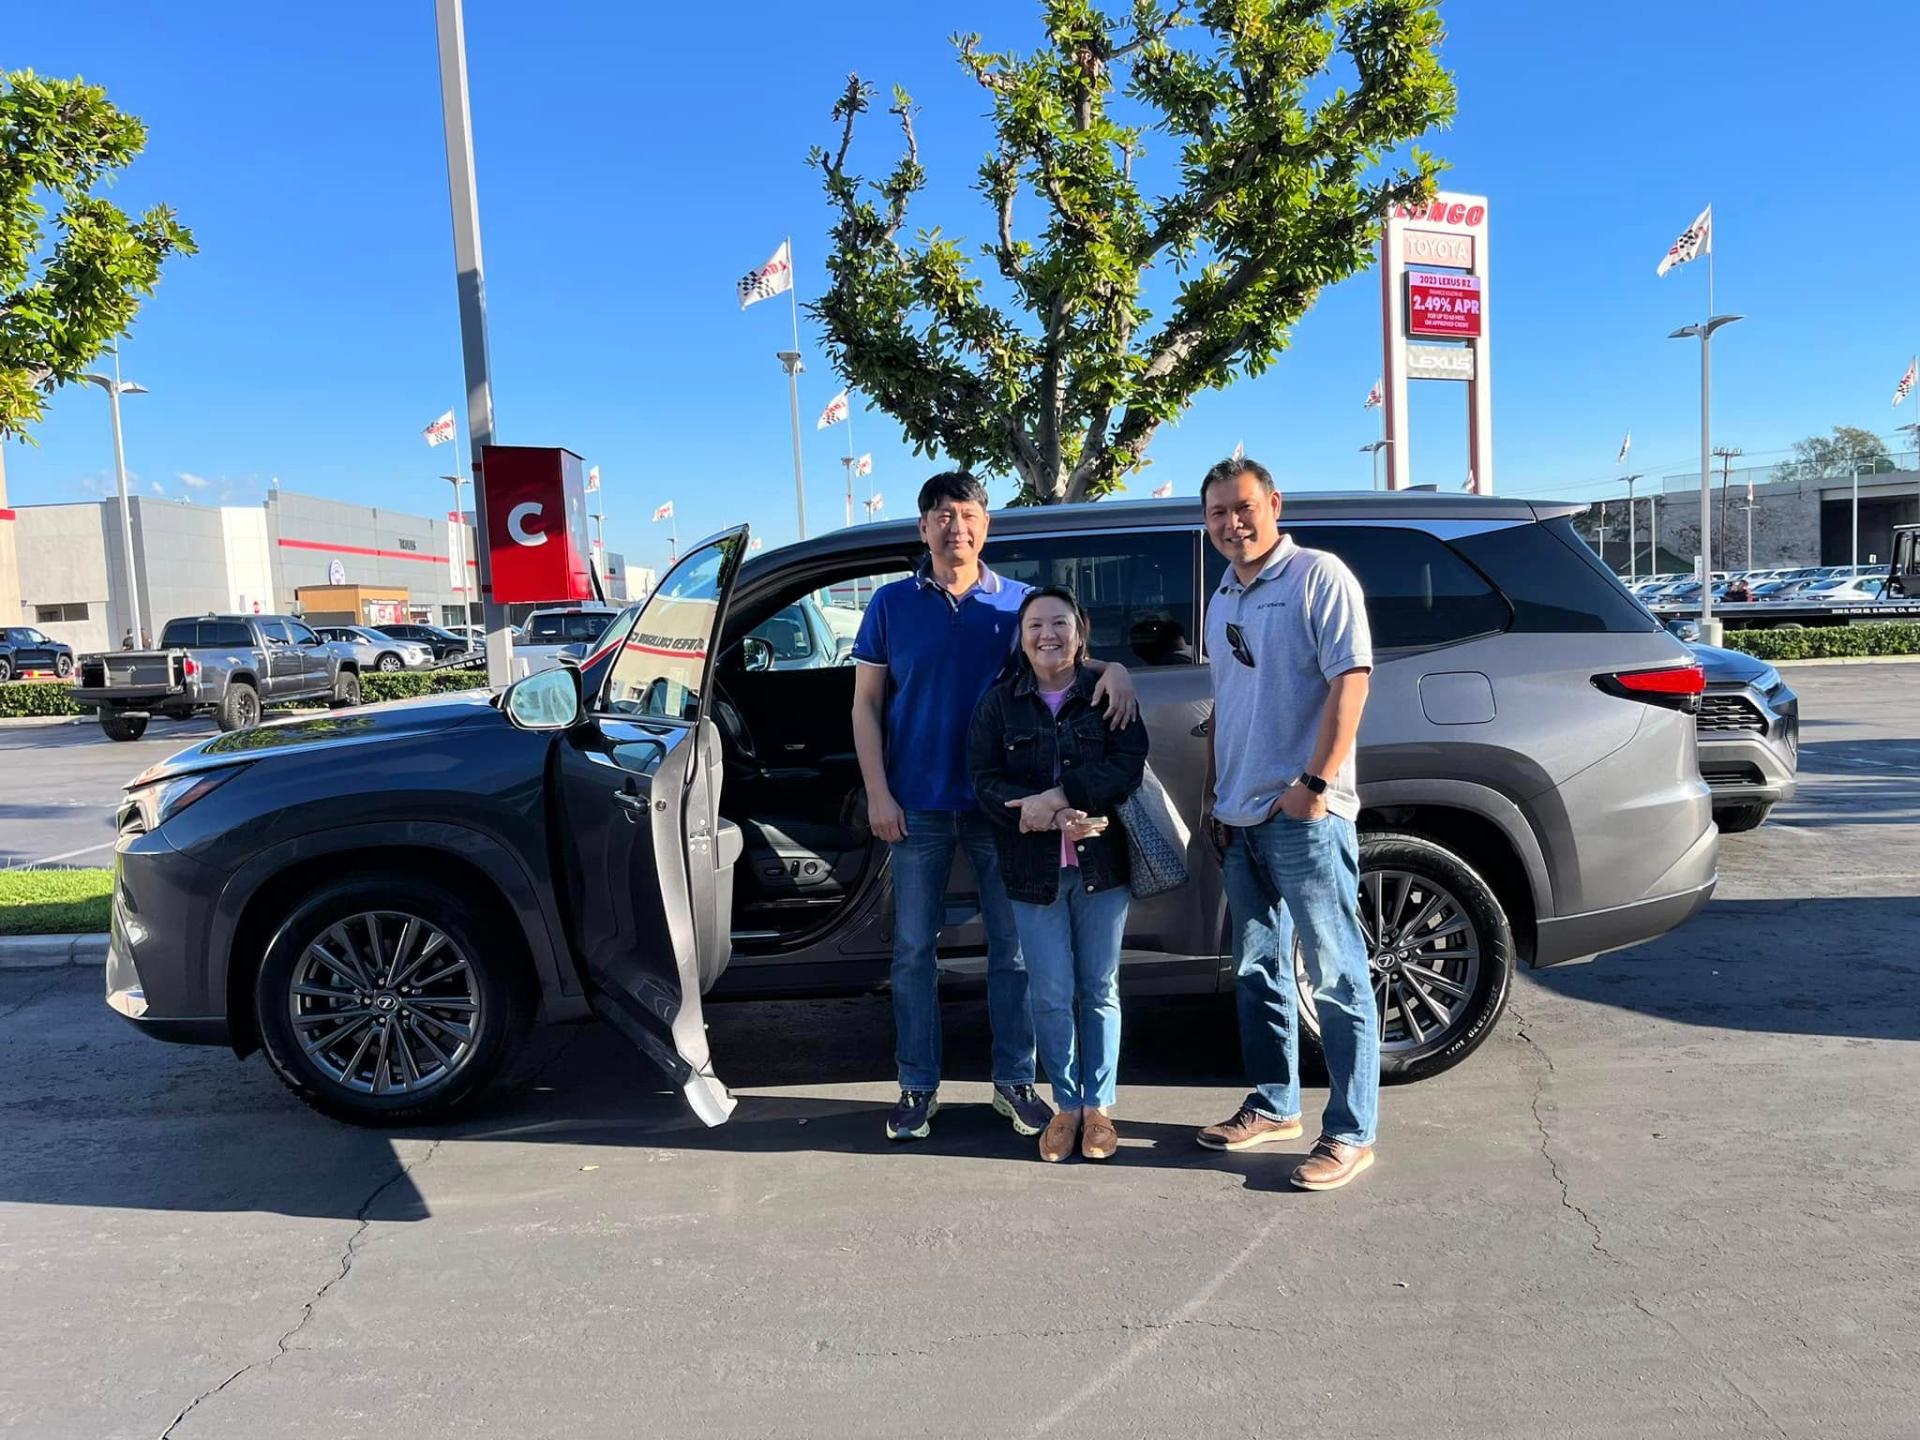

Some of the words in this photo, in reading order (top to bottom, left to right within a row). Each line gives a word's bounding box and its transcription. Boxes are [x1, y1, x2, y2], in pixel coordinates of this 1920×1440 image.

[1407, 237, 1466, 259] TOYOTA
[1420, 275, 1437, 285] 2023
[1438, 276, 1461, 286] LEXUS
[1413, 295, 1452, 313] 2.49%
[1454, 299, 1480, 315] APR
[1408, 353, 1471, 371] LEXUS
[507, 501, 549, 547] C
